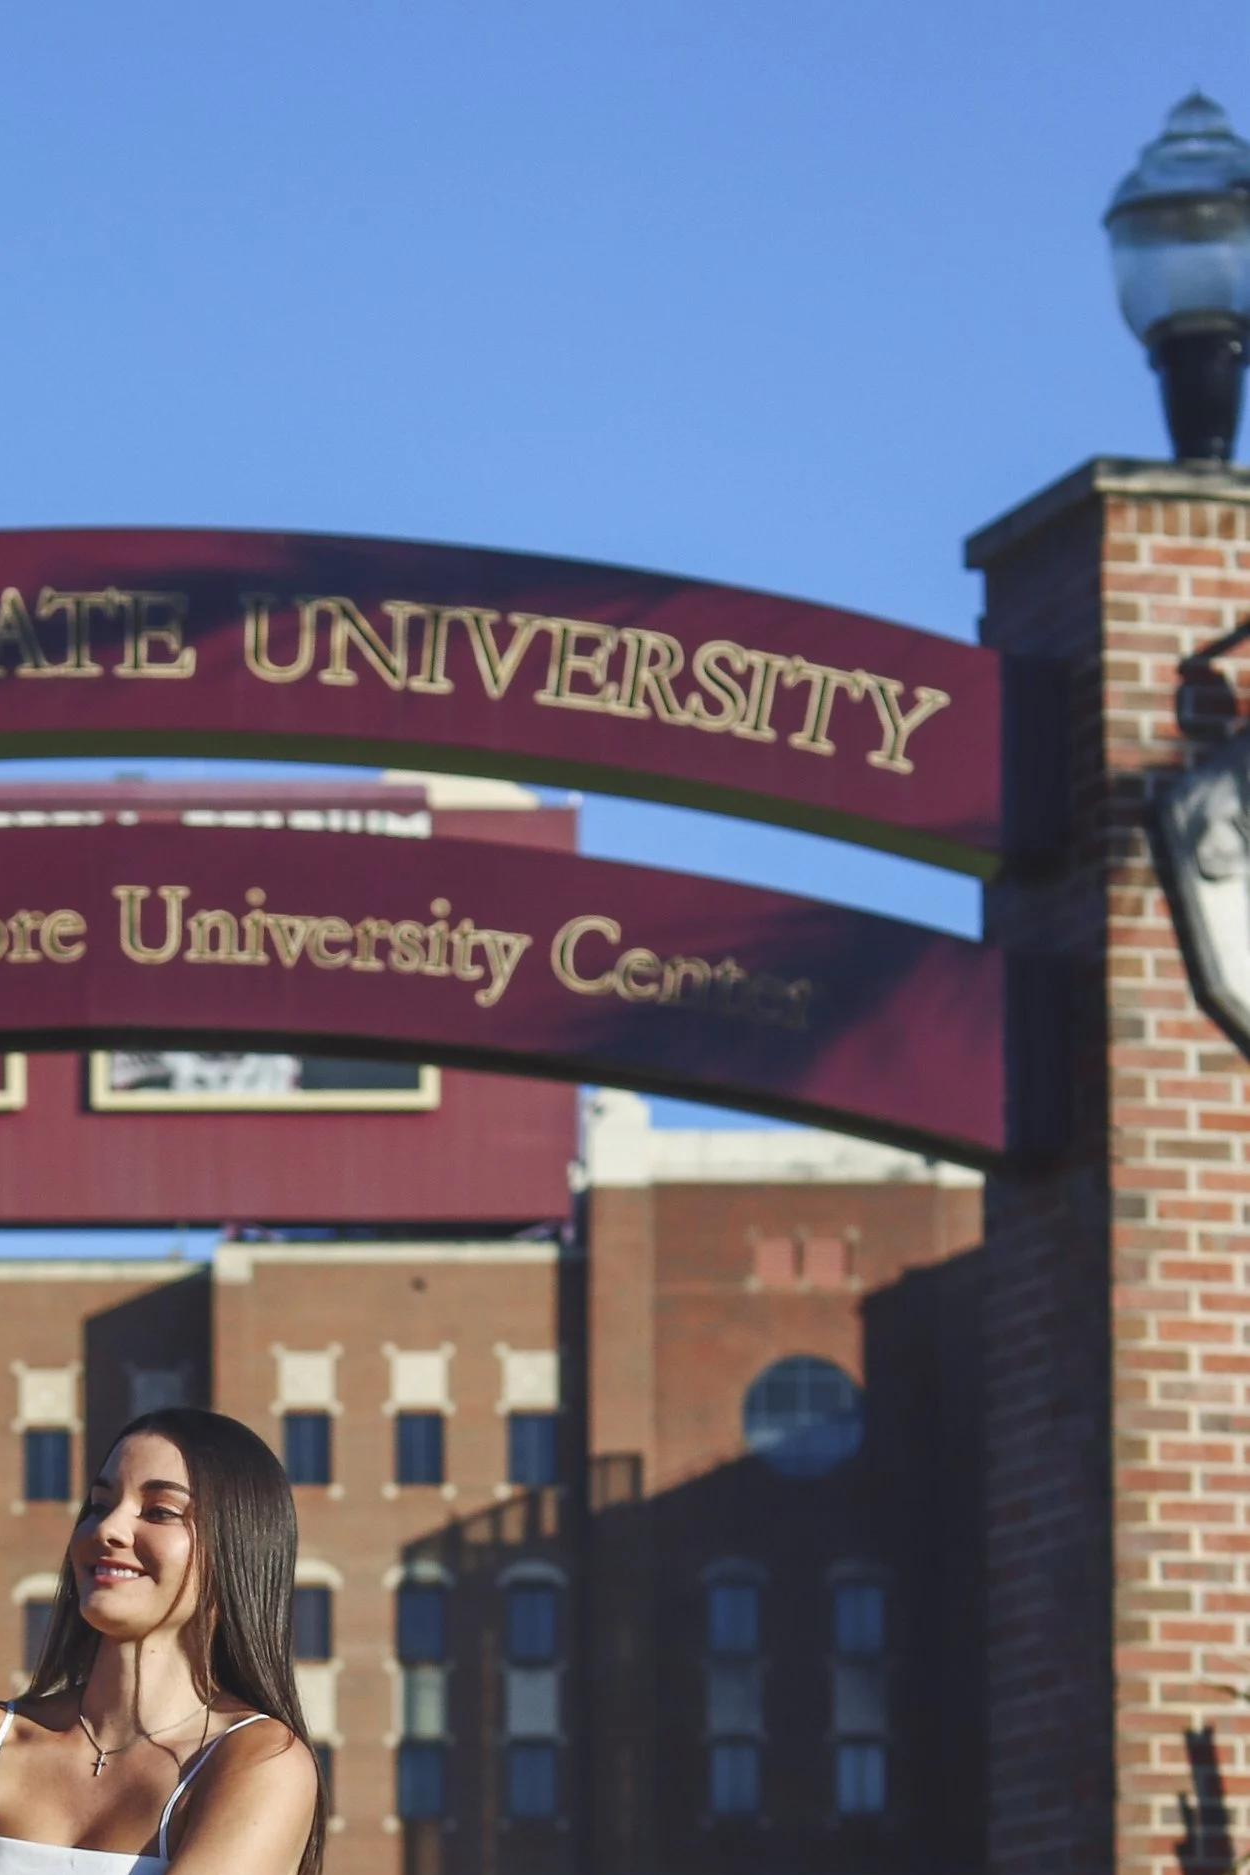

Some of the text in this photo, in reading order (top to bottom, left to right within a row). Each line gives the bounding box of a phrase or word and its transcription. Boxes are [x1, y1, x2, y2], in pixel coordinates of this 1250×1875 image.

[243, 596, 951, 775] UNIVERSITY
[112, 885, 533, 1008] University
[550, 914, 812, 1030] Center
